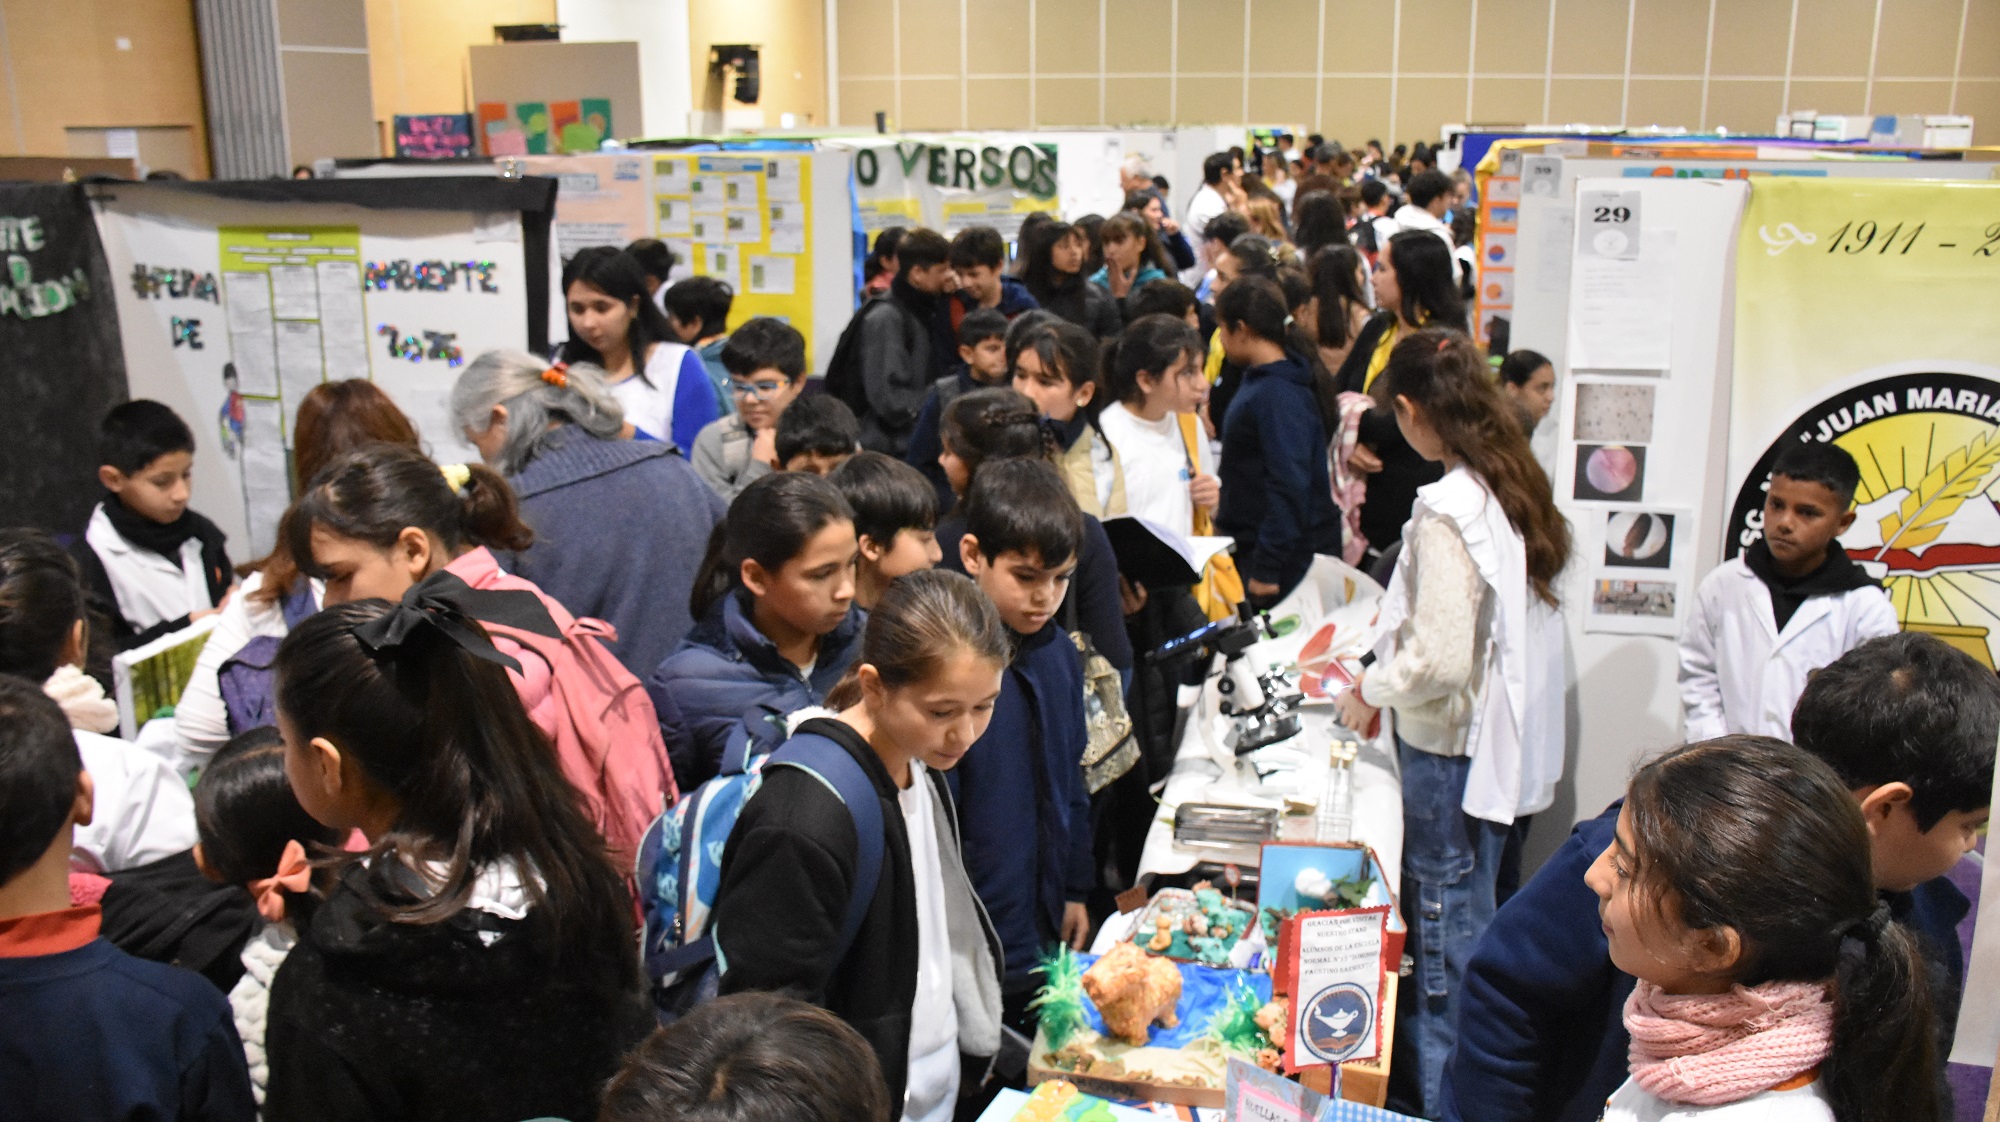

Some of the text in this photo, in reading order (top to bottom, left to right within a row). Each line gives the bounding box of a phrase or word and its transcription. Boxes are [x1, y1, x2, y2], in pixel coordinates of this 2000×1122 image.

[895, 142, 1058, 200] VERSOS
[1593, 206, 1632, 223] 29
[0, 215, 47, 252] TE
[1827, 220, 1926, 255] 1911
[364, 259, 500, 294] AMBIENTE
[171, 316, 204, 350] DE
[1906, 386, 2000, 423] MARIA
[1307, 919, 1338, 927] GRACIAS
[1352, 914, 1378, 922] VISITAR
[1302, 945, 1333, 954] ALUMNOS
[1354, 939, 1380, 948] ESCUELA
[1317, 930, 1347, 938] NUESTRO
[1303, 956, 1332, 964] NORMAL
[1304, 967, 1339, 975] FAUSTINO
